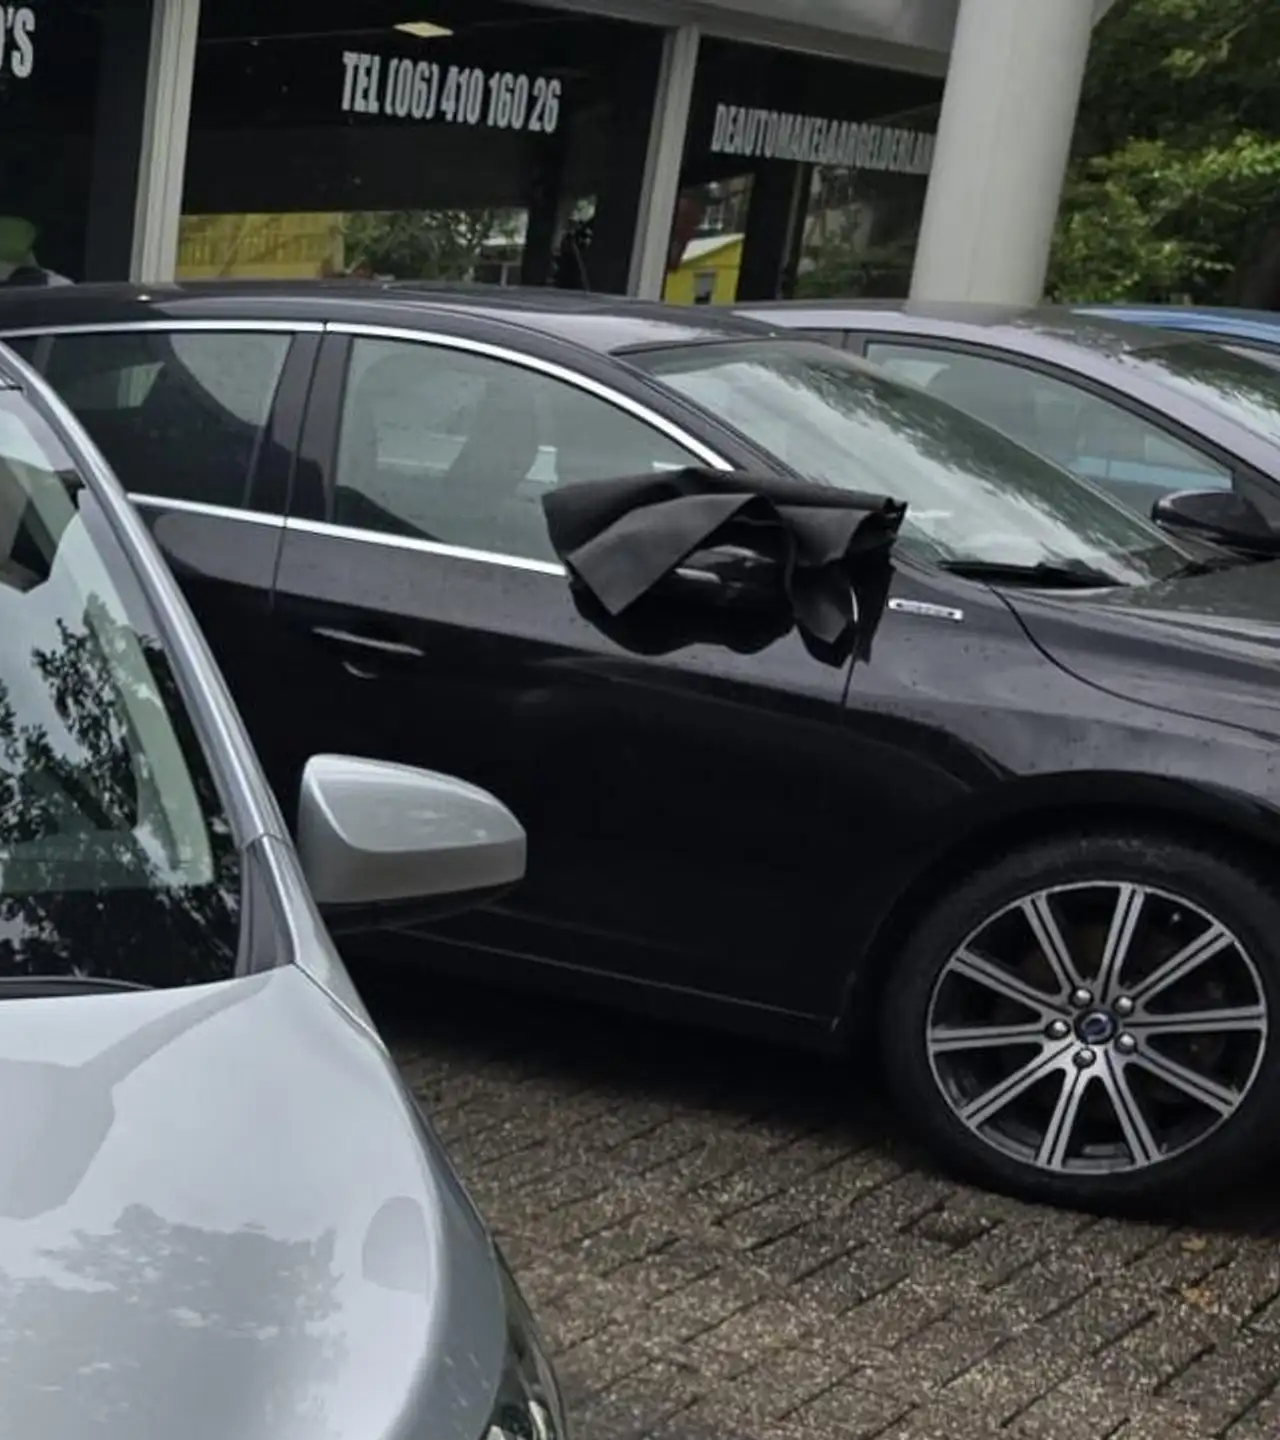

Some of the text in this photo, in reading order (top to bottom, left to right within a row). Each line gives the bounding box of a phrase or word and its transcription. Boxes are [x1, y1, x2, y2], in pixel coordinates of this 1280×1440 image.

[342, 51, 562, 133] TEL (06) 410 160 26
